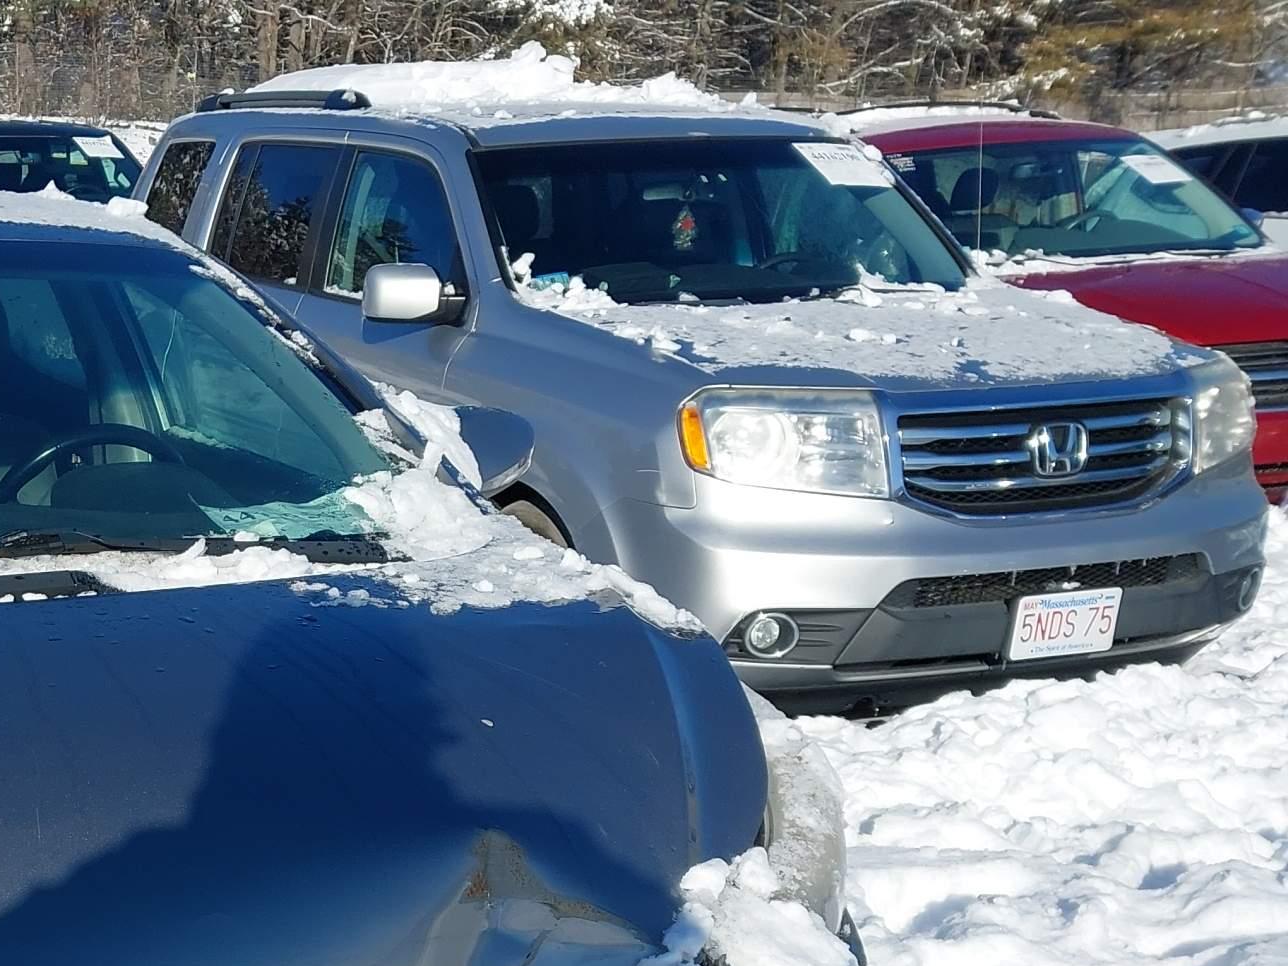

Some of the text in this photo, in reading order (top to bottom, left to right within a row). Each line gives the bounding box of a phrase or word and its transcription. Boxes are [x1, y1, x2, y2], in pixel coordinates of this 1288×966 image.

[1023, 601, 1038, 611] MAY
[1043, 596, 1098, 609] Massachusetts
[1020, 605, 1115, 643] 5NDS 75
